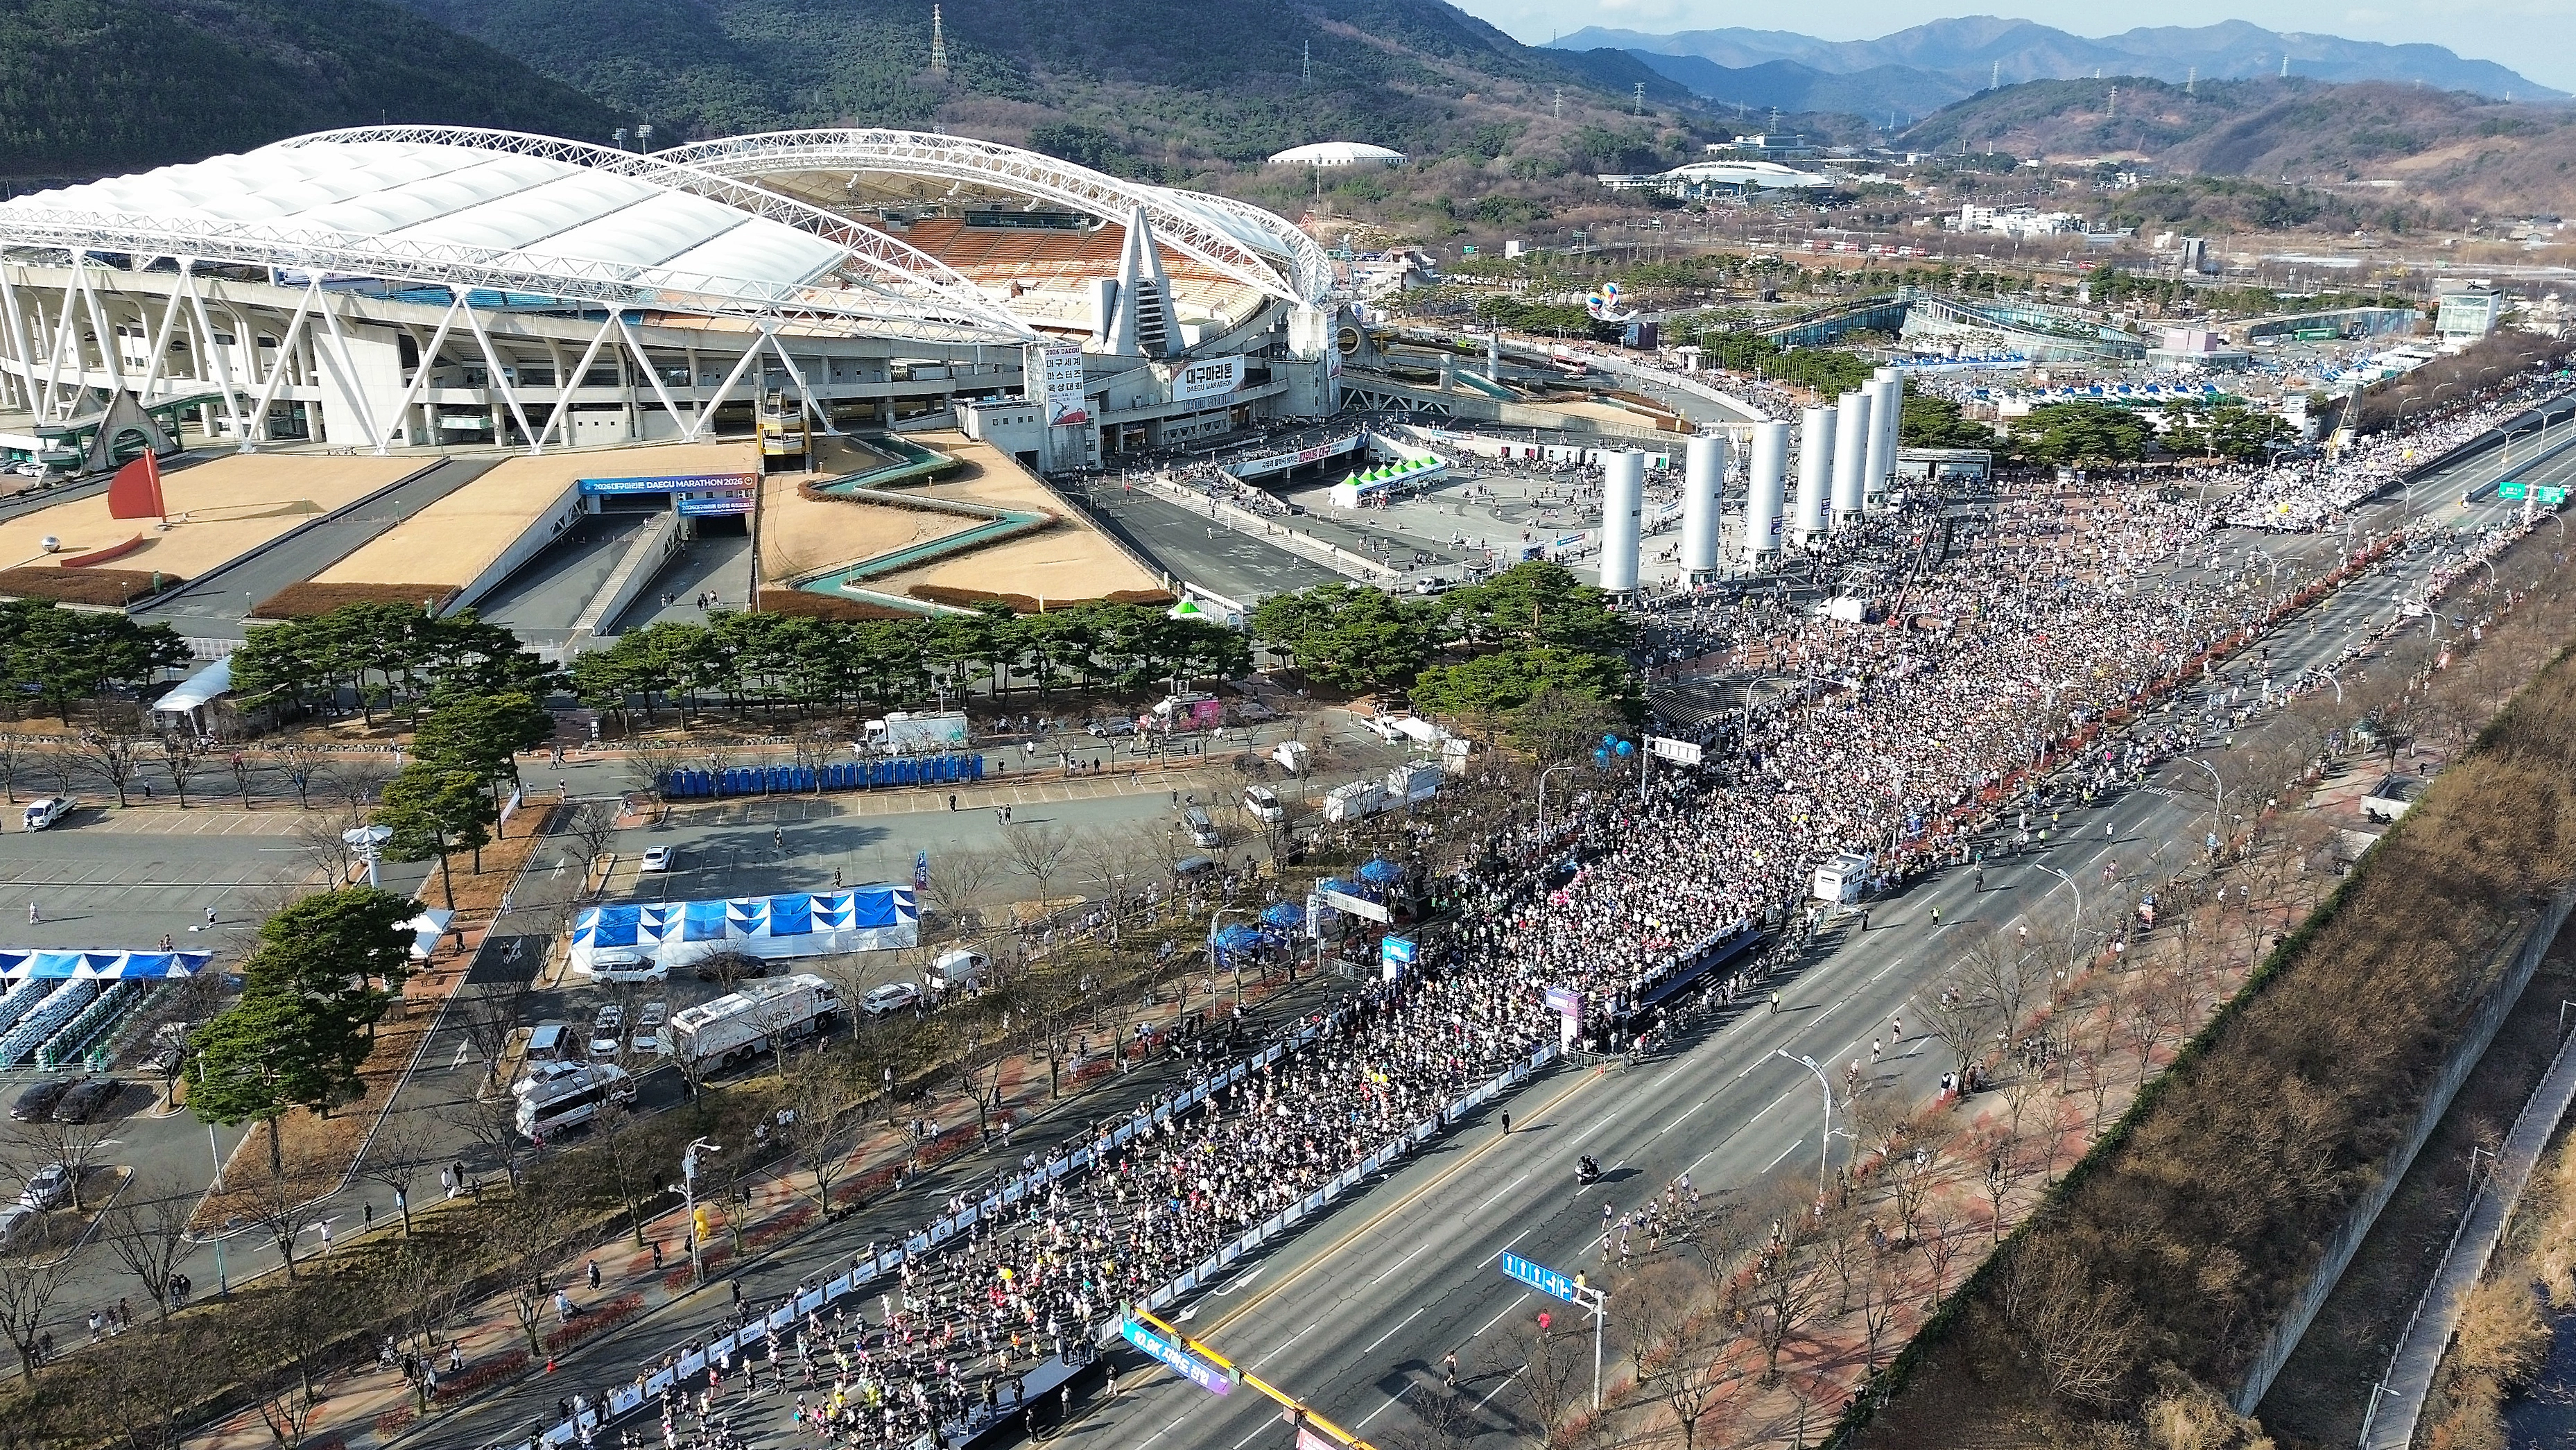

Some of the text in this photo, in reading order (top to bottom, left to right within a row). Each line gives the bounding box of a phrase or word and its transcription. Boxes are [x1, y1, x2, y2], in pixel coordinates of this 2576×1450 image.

[1047, 370, 1082, 380] 마스터즈
[1186, 363, 1232, 384] 대구마라톤
[1048, 382, 1082, 392] 육상대회
[1186, 379, 1232, 392] DAEGU MARATHON
[646, 480, 675, 489] DAEGU
[676, 478, 723, 487] MARATHON
[724, 477, 743, 485] 2026
